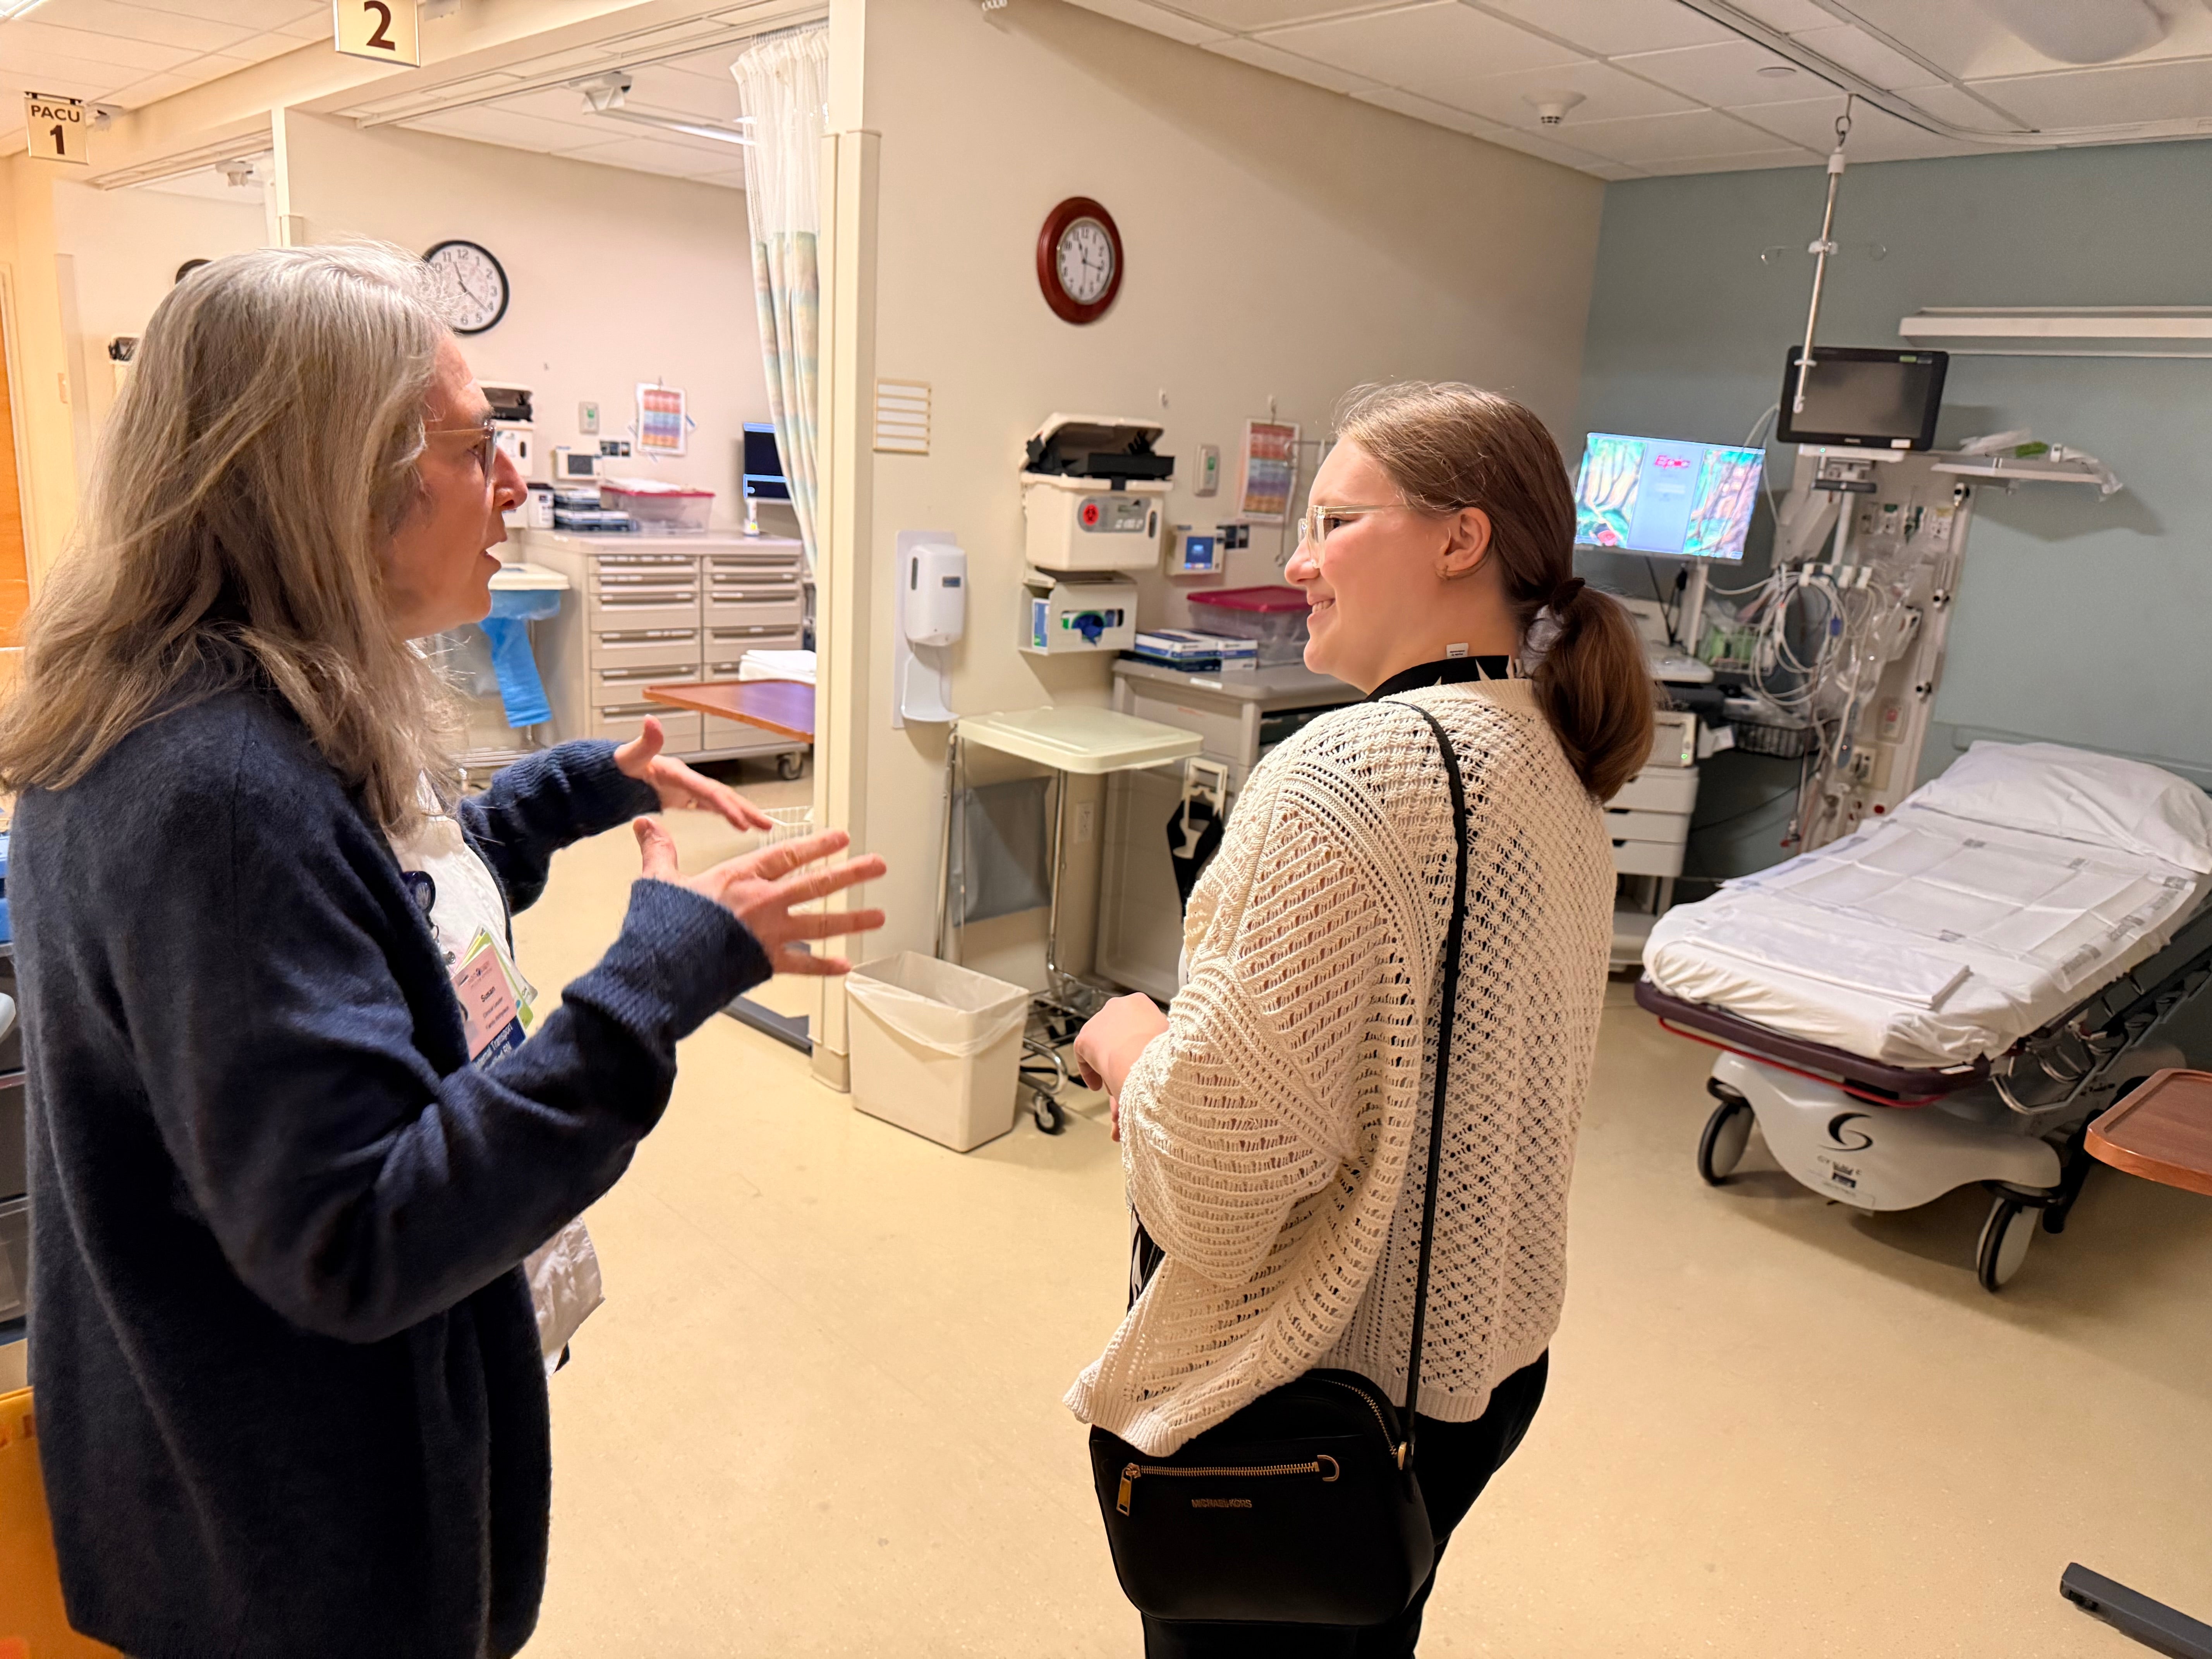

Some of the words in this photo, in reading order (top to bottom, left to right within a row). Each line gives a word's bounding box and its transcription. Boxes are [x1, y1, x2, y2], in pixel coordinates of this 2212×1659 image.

[364, 0, 395, 51] 2
[31, 105, 80, 122] PACU
[50, 125, 65, 155] 1
[1229, 1498, 1252, 1508] KORS
